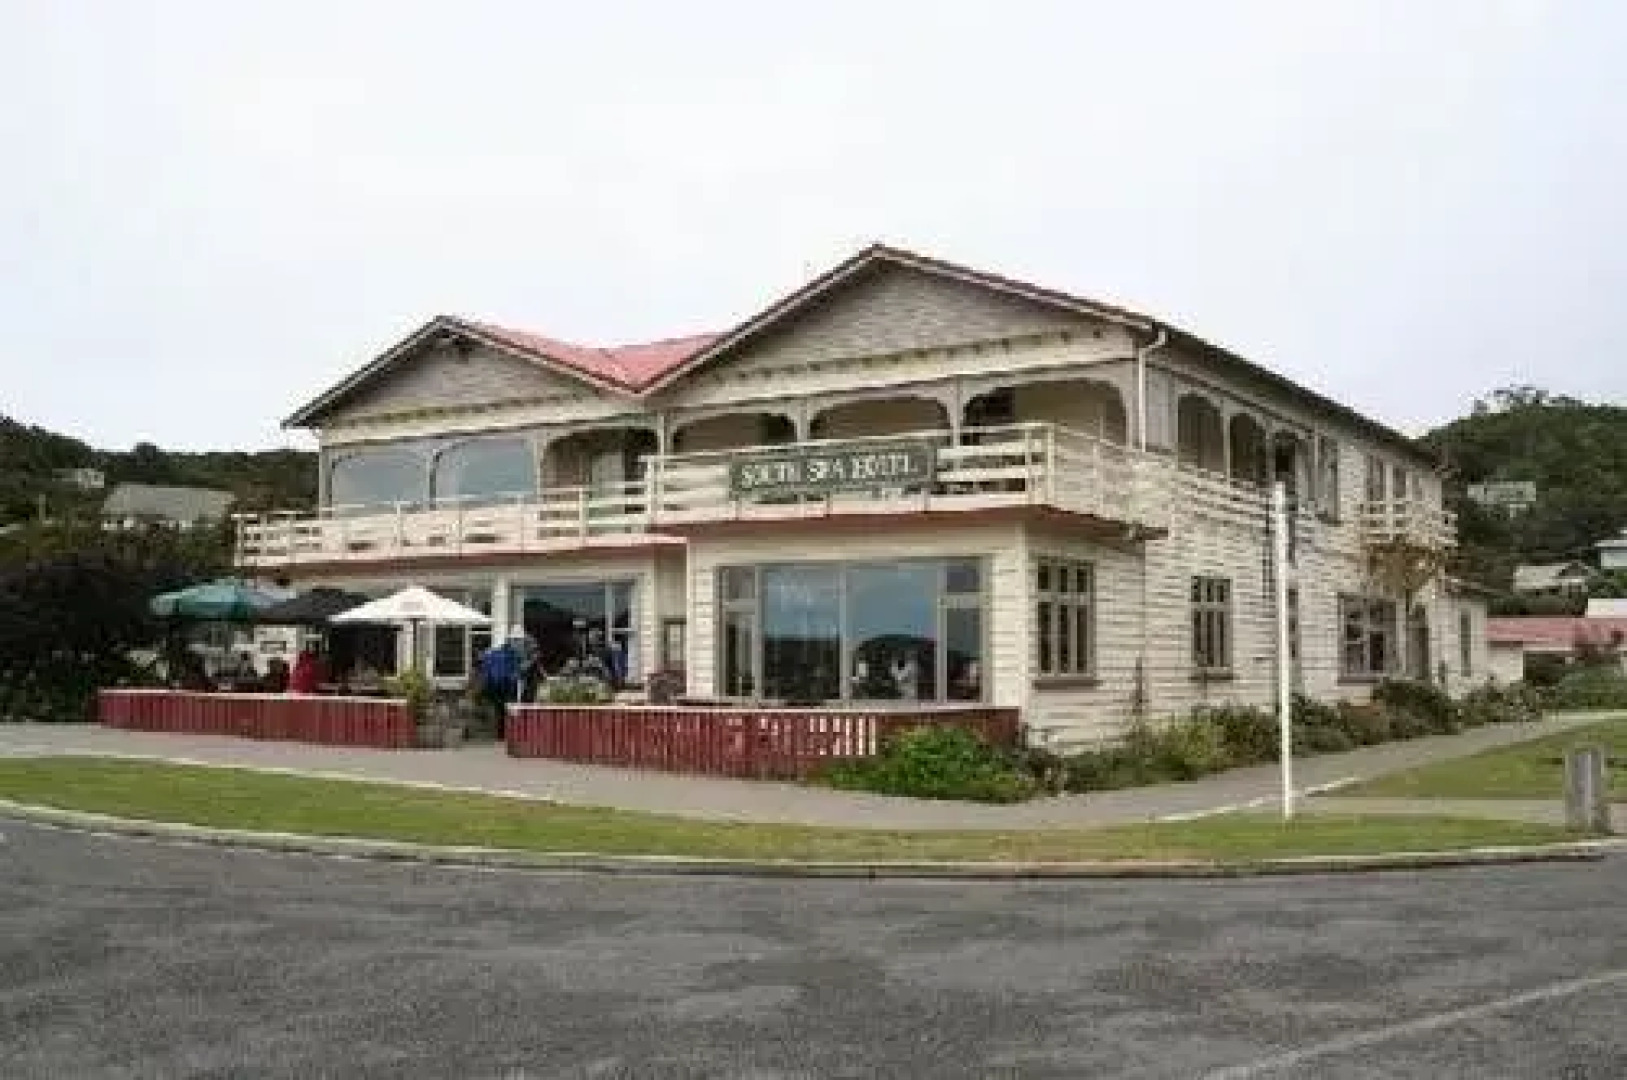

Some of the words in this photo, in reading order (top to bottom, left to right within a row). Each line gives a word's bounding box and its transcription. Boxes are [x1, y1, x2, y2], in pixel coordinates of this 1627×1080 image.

[740, 463, 801, 486] SOUTH
[806, 458, 846, 482] SEA
[851, 452, 920, 480] HOTEL
